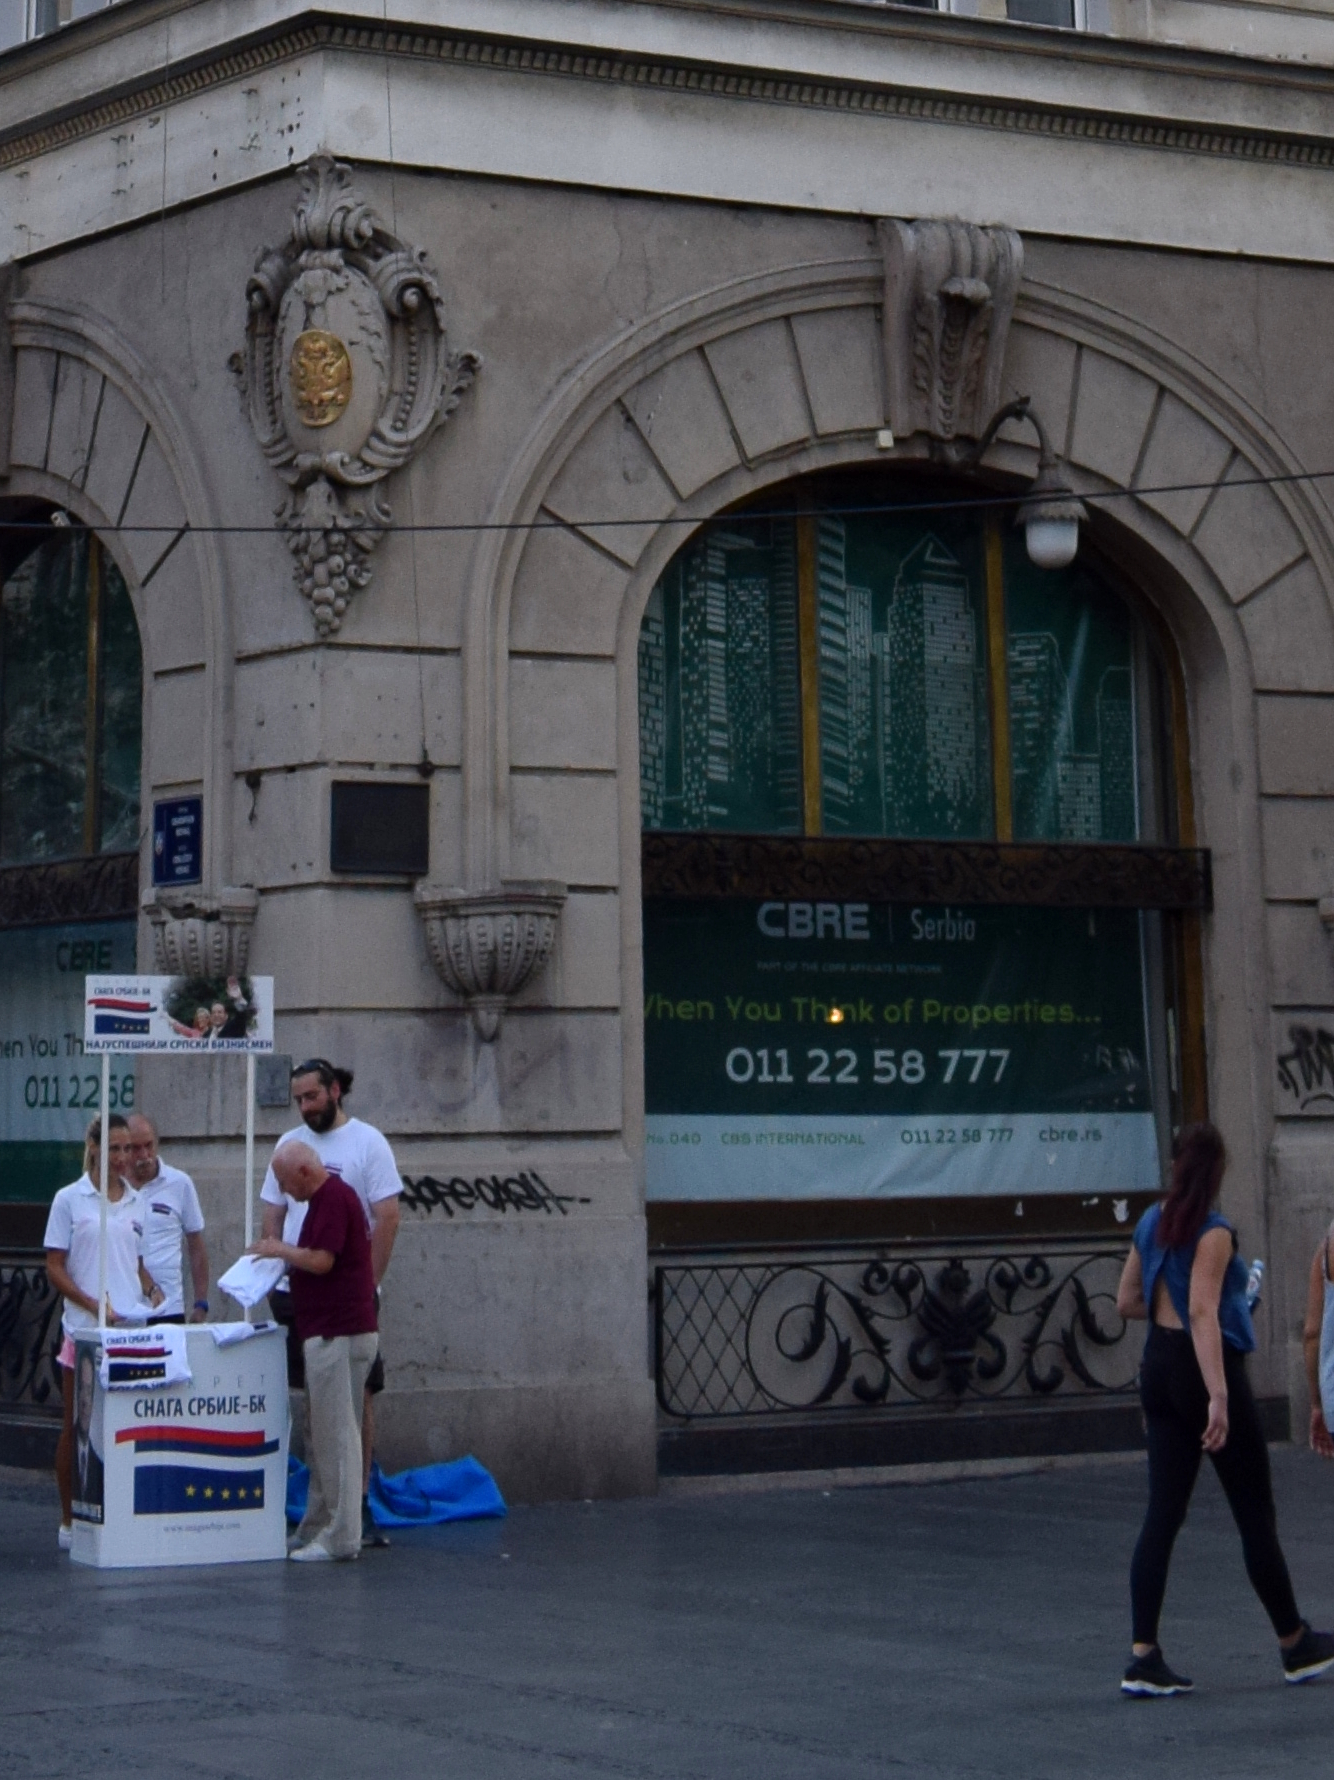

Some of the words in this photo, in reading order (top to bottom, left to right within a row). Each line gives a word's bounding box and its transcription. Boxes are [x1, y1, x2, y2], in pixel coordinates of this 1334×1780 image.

[756, 901, 871, 940] CBRE
[910, 907, 976, 941] Serbia
[56, 940, 114, 972] CBRE
[724, 995, 782, 1022] You
[883, 998, 914, 1024] of
[922, 998, 1102, 1029] Properties...
[28, 1032, 58, 1057] You
[170, 1039, 209, 1049] СРПСКИ
[725, 1047, 794, 1083] 011
[806, 1048, 859, 1084] 22
[873, 1048, 926, 1084] 58
[938, 1048, 1011, 1084] 777
[24, 1074, 61, 1109] 011
[67, 1074, 100, 1109] 22
[900, 1128, 931, 1145] 011
[934, 1128, 956, 1144] 22
[961, 1127, 982, 1144] 58
[987, 1127, 1014, 1144] 777
[1038, 1126, 1103, 1144] cbre.rs
[133, 1397, 184, 1418] СНАГА
[187, 1394, 267, 1417] СРБИЈЕ-БК
